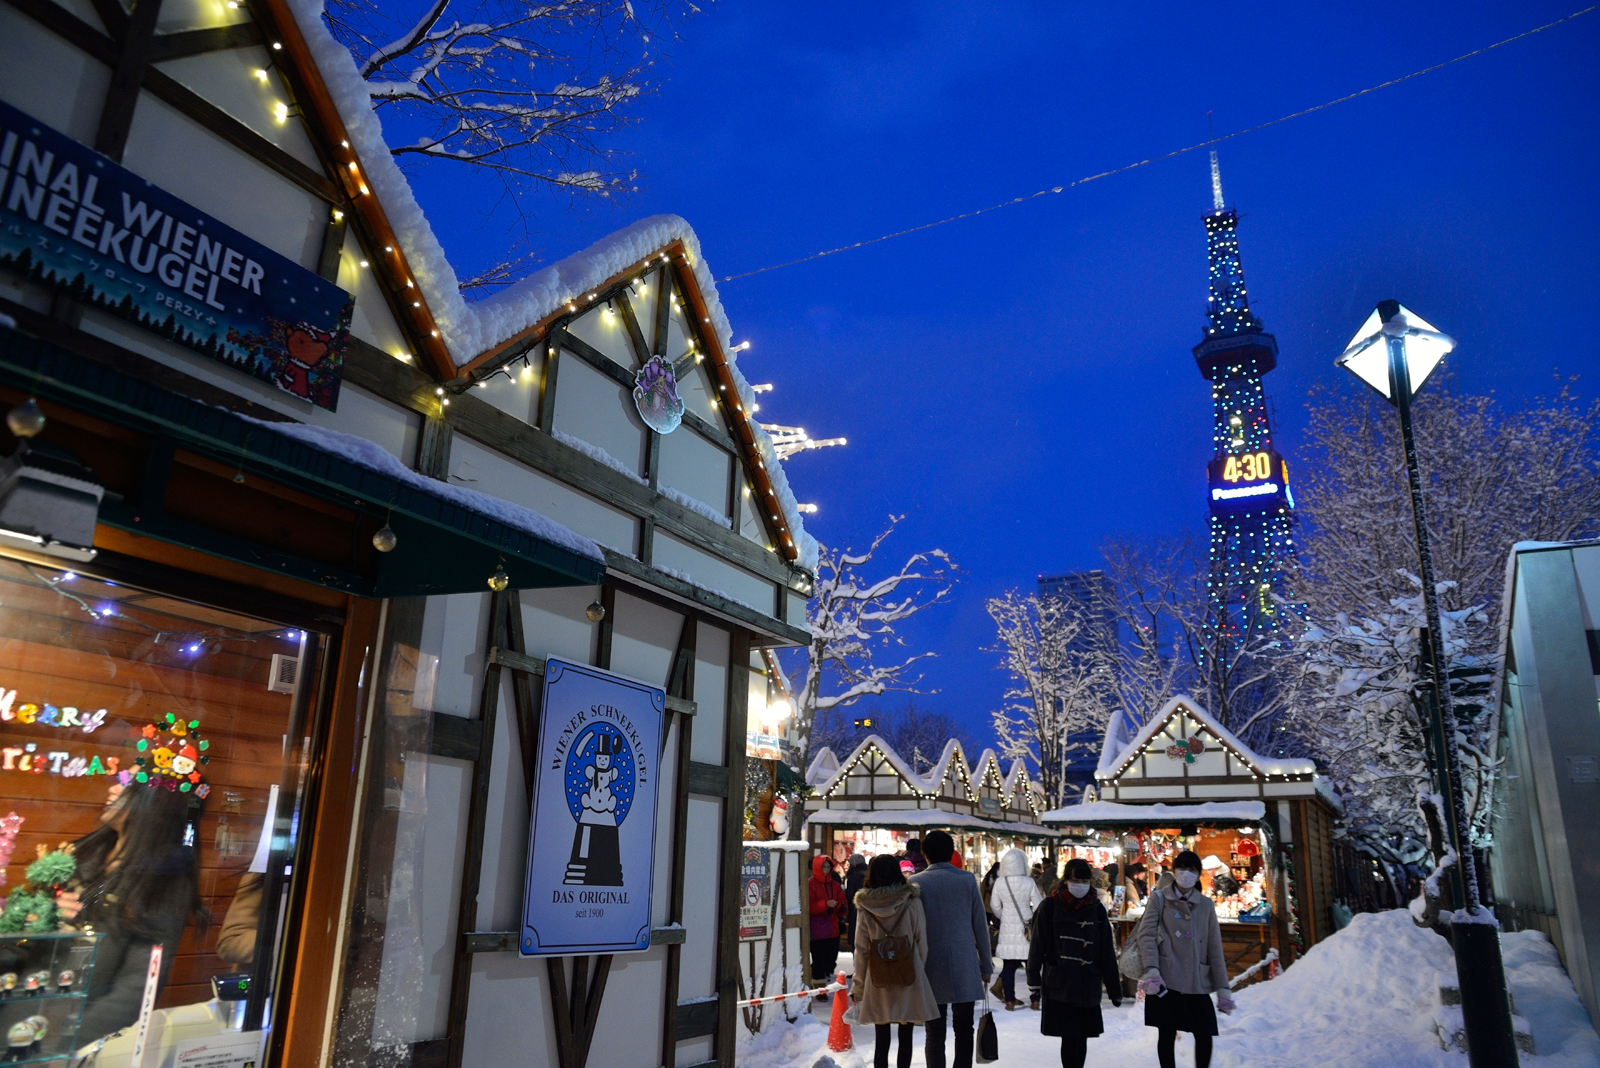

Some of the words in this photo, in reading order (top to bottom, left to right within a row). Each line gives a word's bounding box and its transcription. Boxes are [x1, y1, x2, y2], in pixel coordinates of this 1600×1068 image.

[121, 191, 265, 296] WIENER
[155, 292, 204, 320] PERZY
[1223, 452, 1271, 483] 4:30
[552, 711, 587, 770] WIENER
[591, 704, 647, 788] SCHNEEKUGEL
[552, 890, 575, 904] DAS
[579, 890, 630, 904] ORIGINAL
[575, 908, 587, 918] seit
[588, 908, 604, 918] 1900
